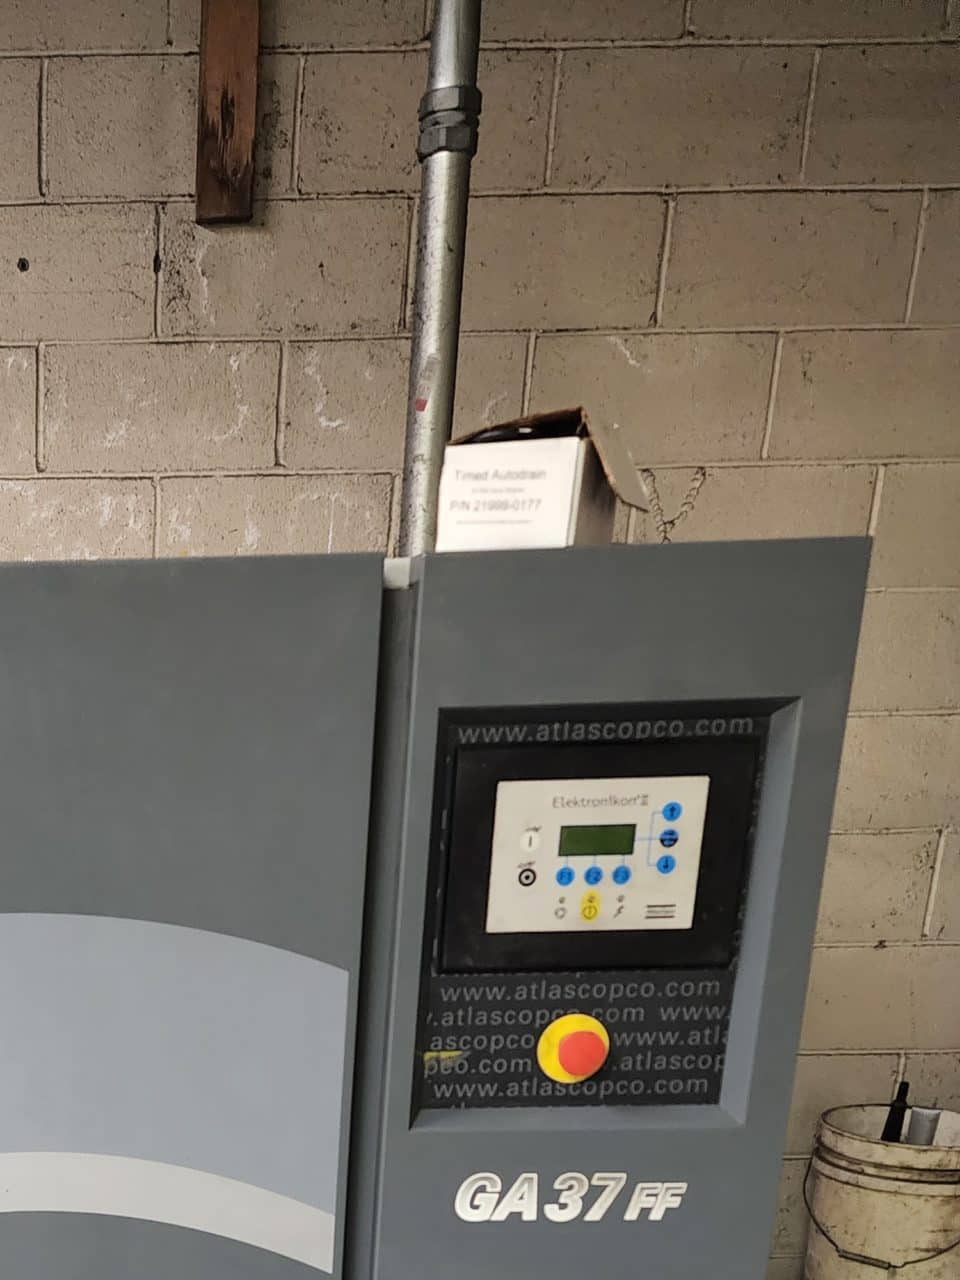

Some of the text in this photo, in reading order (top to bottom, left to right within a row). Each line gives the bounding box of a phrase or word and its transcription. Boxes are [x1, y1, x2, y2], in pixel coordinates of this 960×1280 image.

[458, 717, 754, 744] www.atlascopco.com
[441, 979, 721, 1003] www.atlascopco.com
[434, 1076, 708, 1099] www.atlascopco.com
[454, 1172, 688, 1222] GA 37 FF
